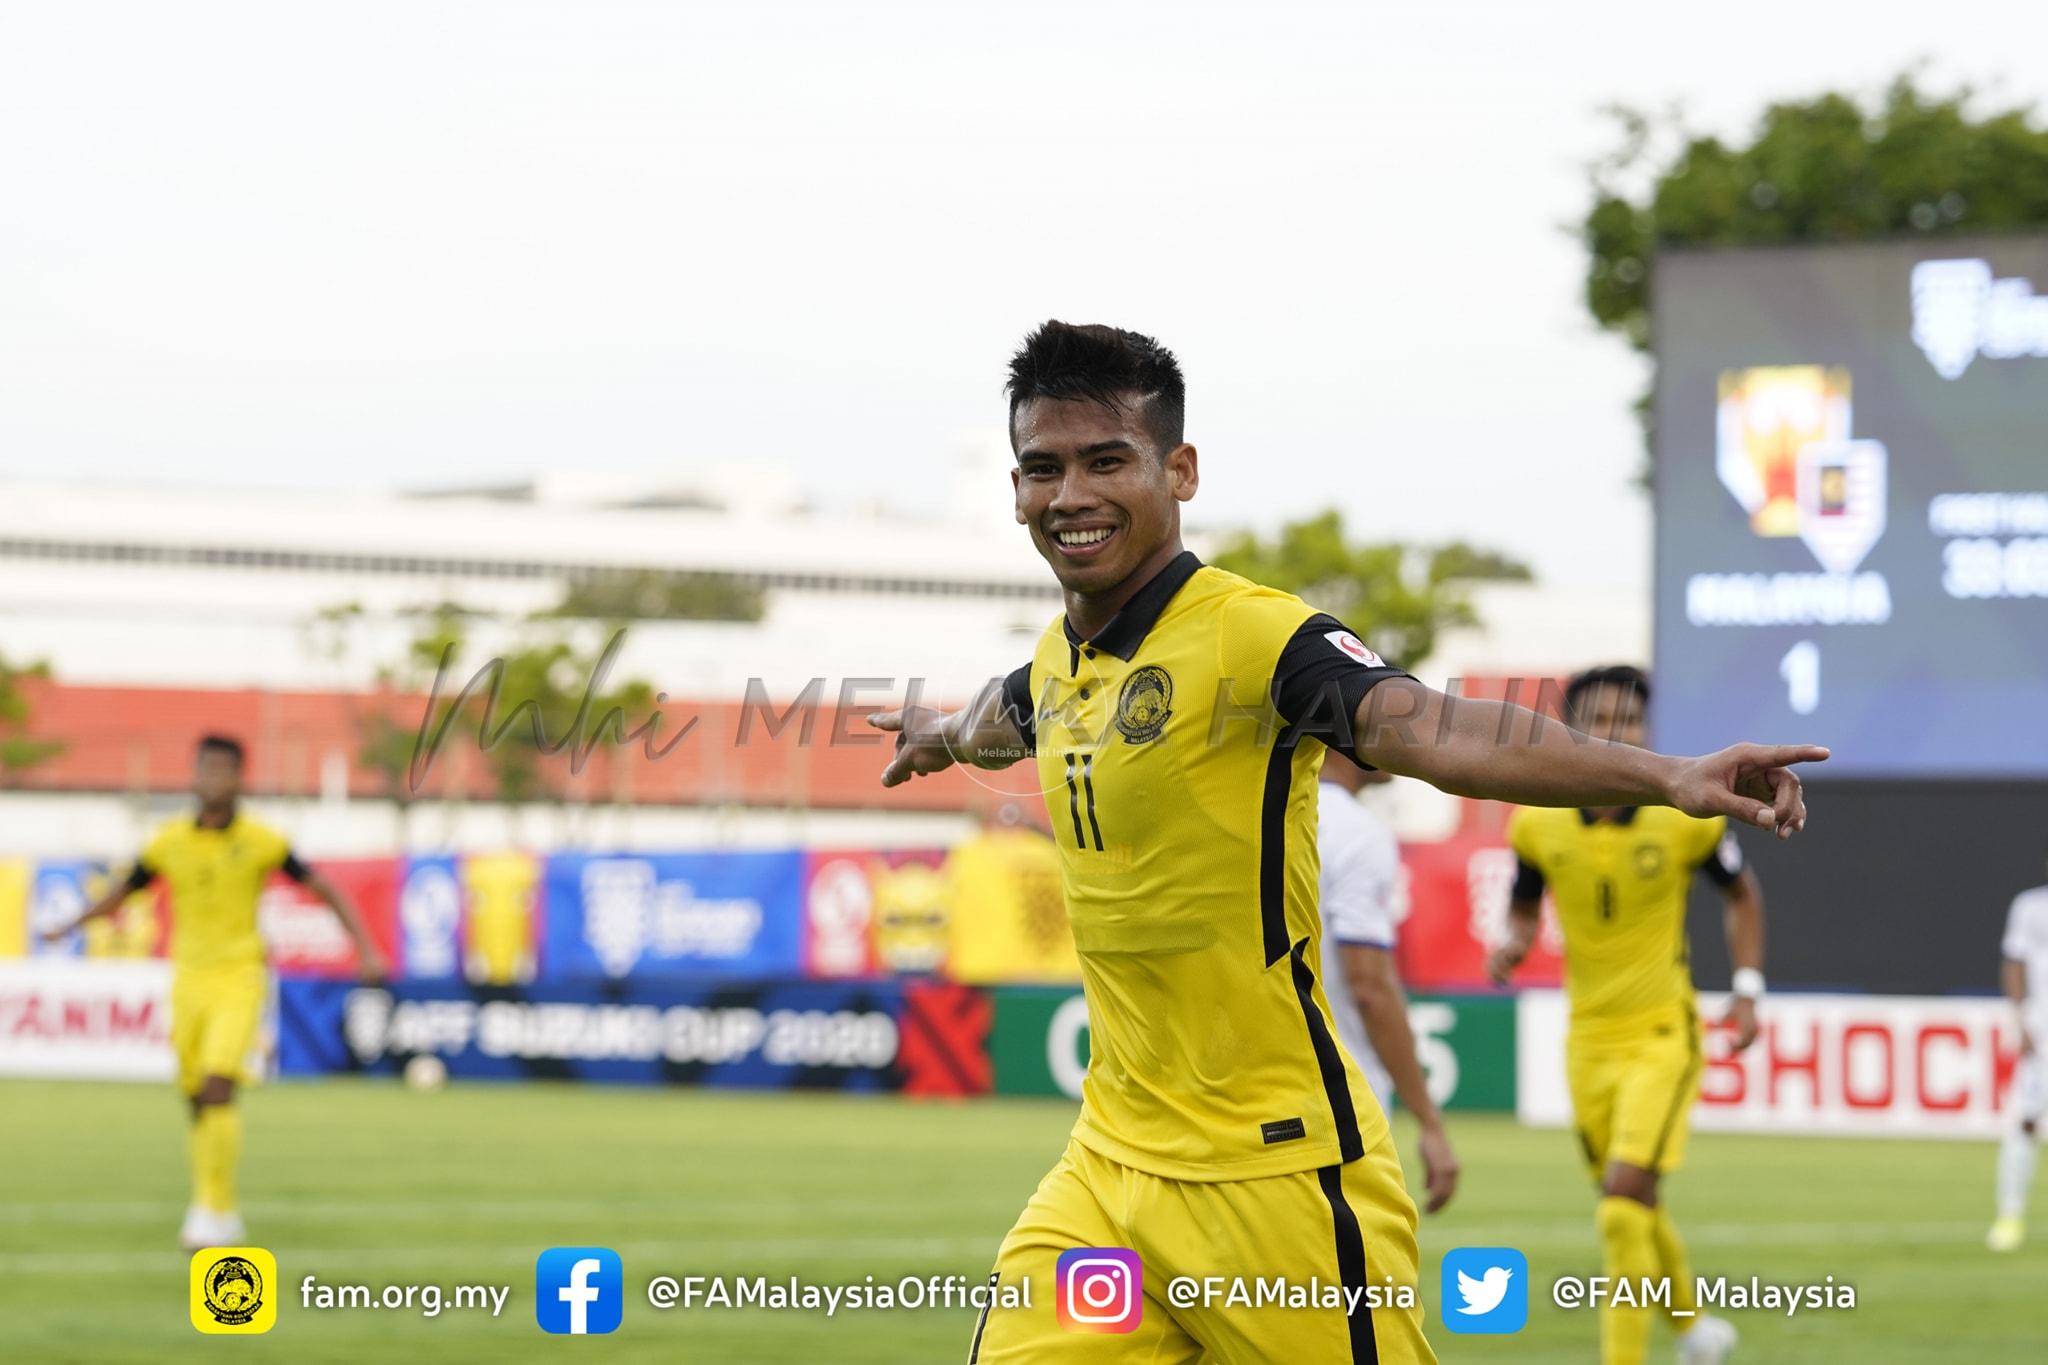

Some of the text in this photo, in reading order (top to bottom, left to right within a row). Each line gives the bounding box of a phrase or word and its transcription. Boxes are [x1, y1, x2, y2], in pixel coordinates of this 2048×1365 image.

[1064, 753, 1104, 851] 11
[660, 1005, 764, 1064] CUP
[764, 1009, 898, 1068] 2020
